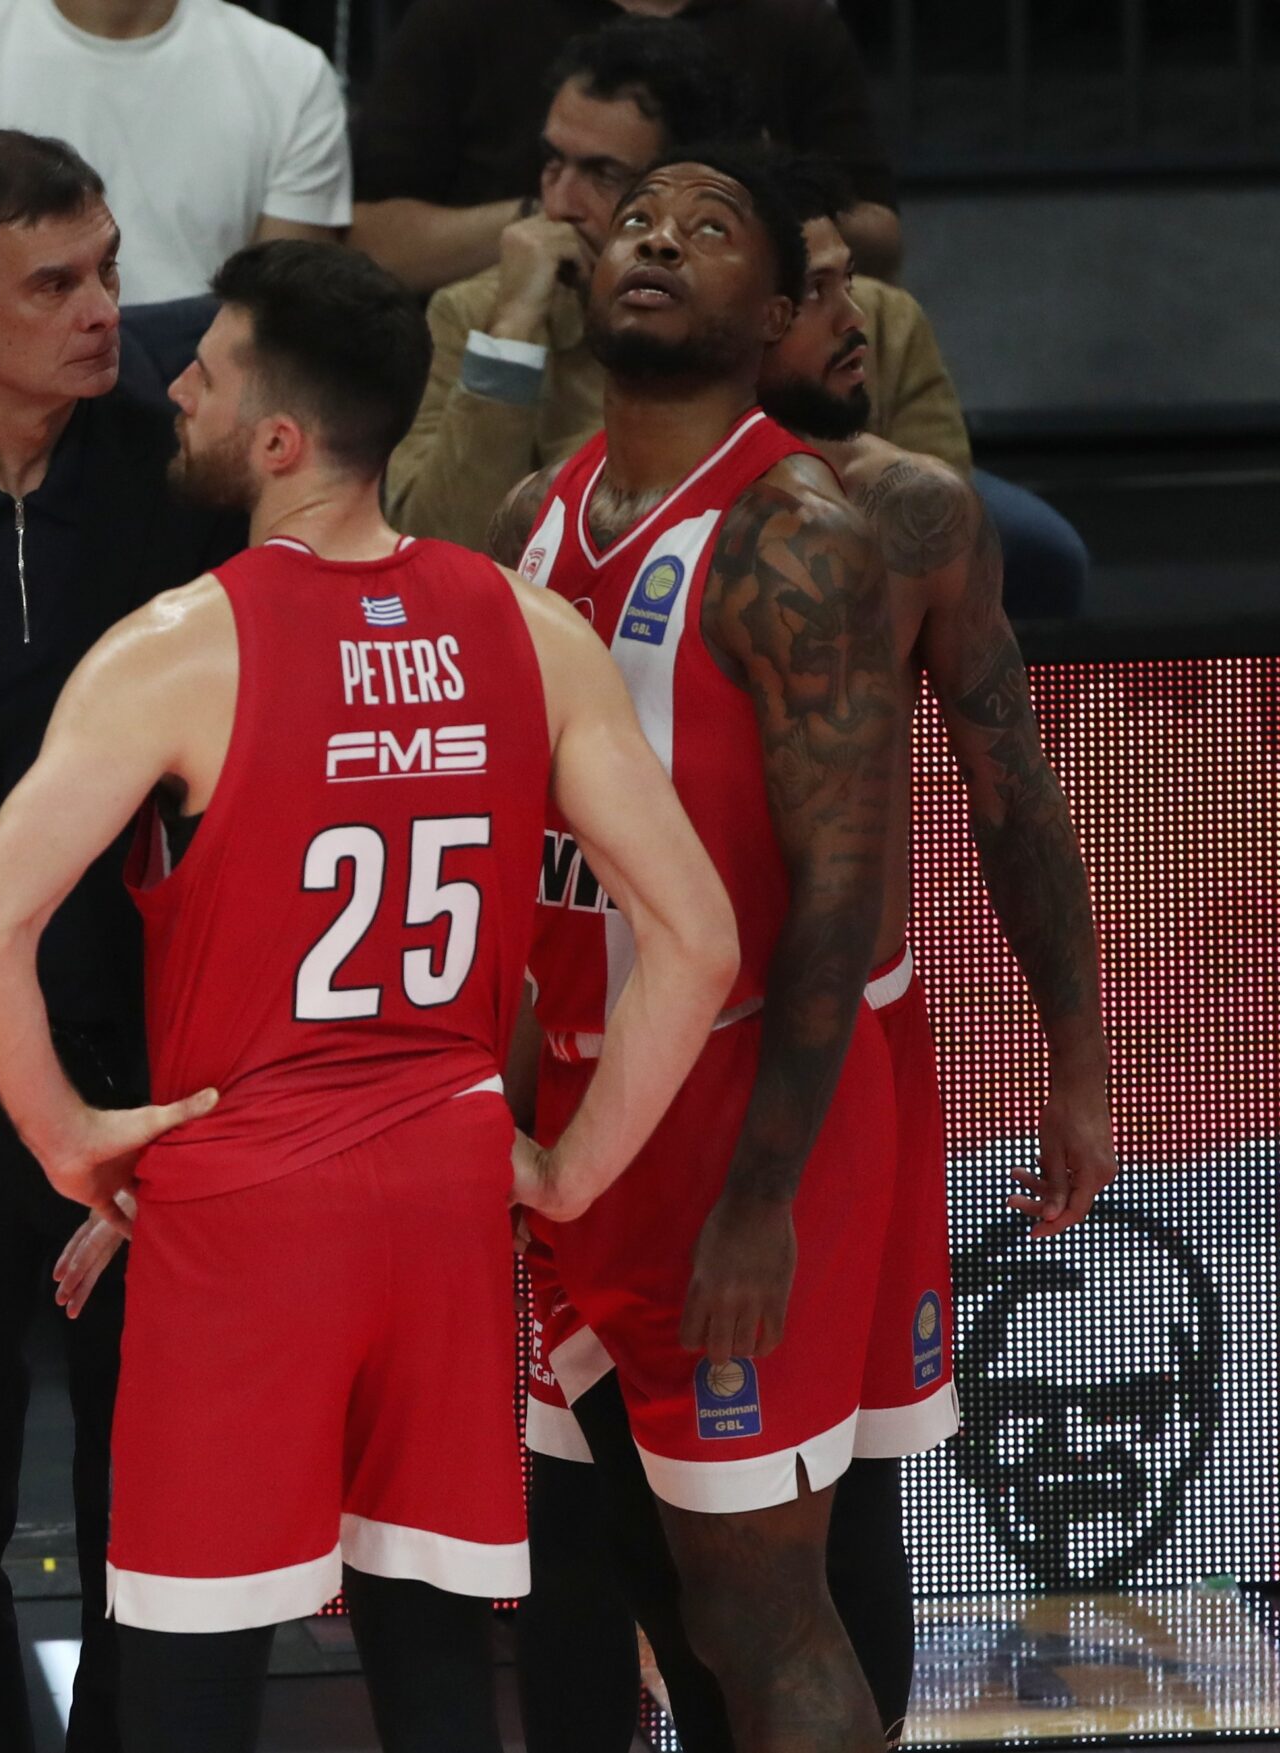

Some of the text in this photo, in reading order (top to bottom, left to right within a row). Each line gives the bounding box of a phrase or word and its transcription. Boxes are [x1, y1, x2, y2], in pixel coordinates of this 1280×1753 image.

[630, 621, 652, 637] GBL
[339, 634, 465, 705] PETERS
[326, 724, 488, 778] FMS
[292, 811, 492, 1023] 25
[715, 1419, 745, 1432] GBL
